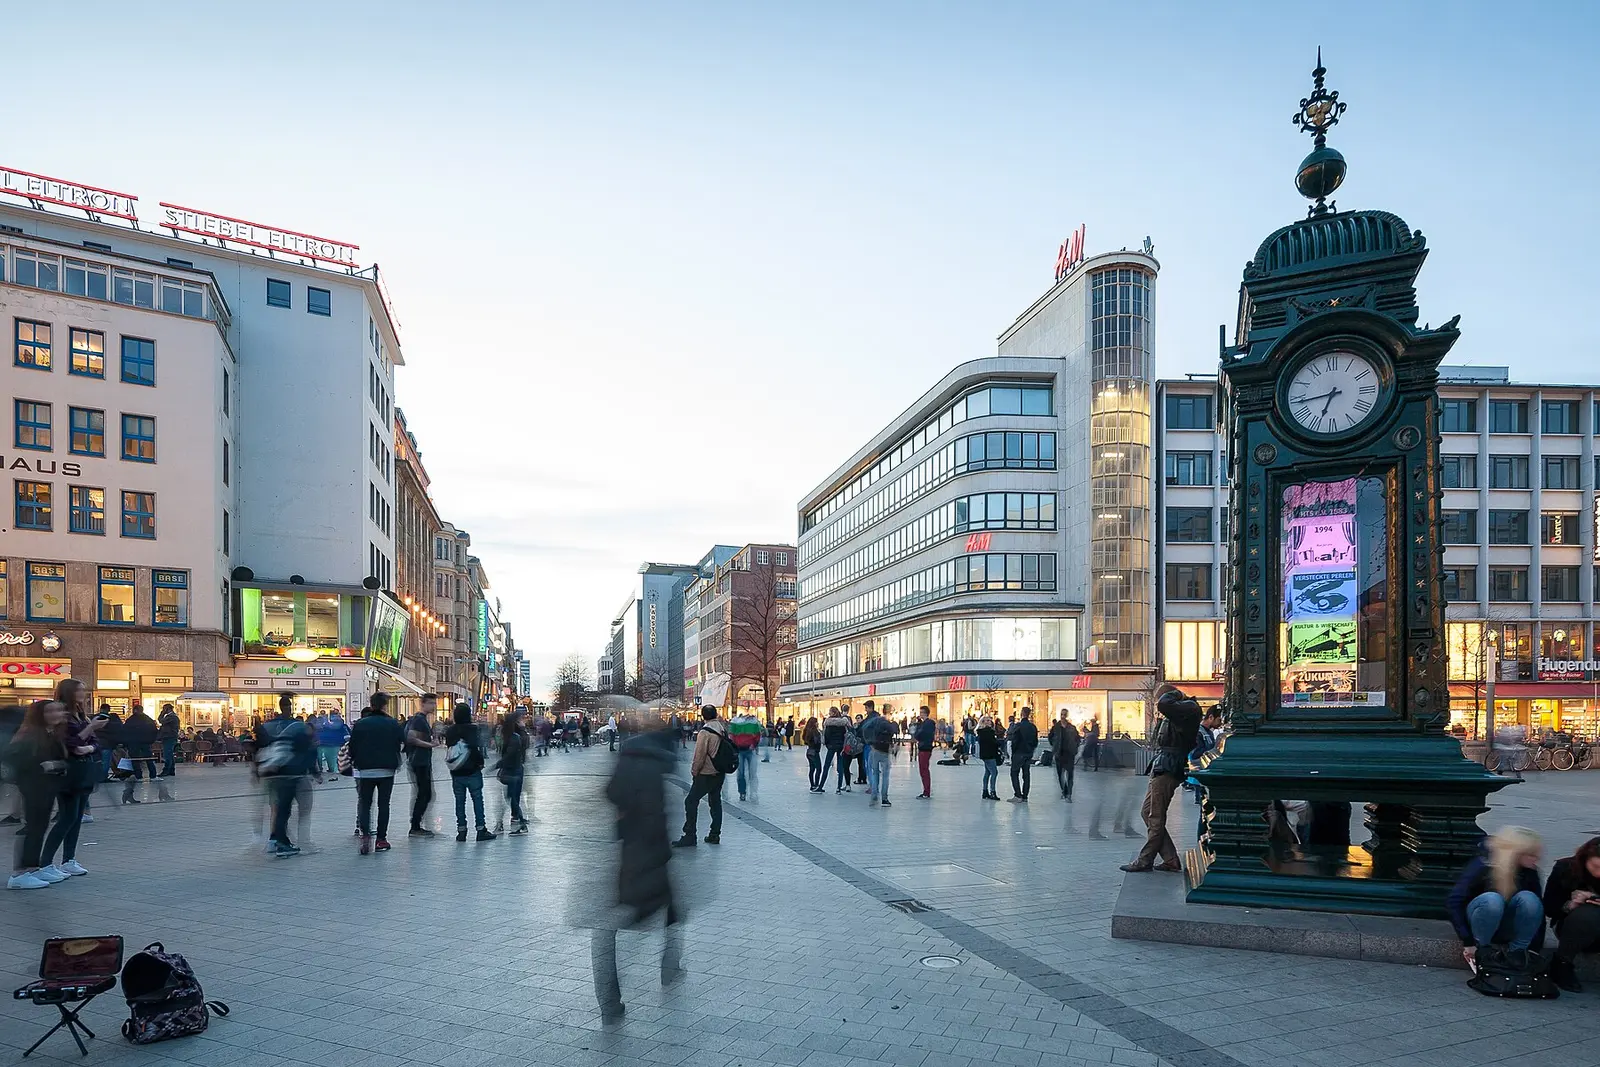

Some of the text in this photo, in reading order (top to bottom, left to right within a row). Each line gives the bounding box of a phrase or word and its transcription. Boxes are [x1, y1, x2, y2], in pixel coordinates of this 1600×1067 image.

[27, 177, 132, 215] ELTRON
[165, 208, 354, 263] STIEBEL ELTRON
[1054, 223, 1086, 280] H&M
[1306, 363, 1322, 379] XI
[1325, 356, 1338, 373] XII
[1345, 358, 1355, 373] I
[1354, 368, 1371, 382] II
[1294, 379, 1311, 388] X
[1359, 385, 1376, 395] III
[1328, 418, 1338, 433] VI
[1345, 413, 1357, 426] V
[0, 455, 81, 477] AUS
[964, 532, 992, 552] H&M
[33, 566, 64, 575] BASE
[104, 571, 131, 580] BASE
[158, 574, 184, 583] BASE
[1, 662, 62, 675] OSK
[1537, 657, 1600, 673] Hugendu
[949, 676, 967, 690] H&M
[1072, 675, 1092, 688] H&M
